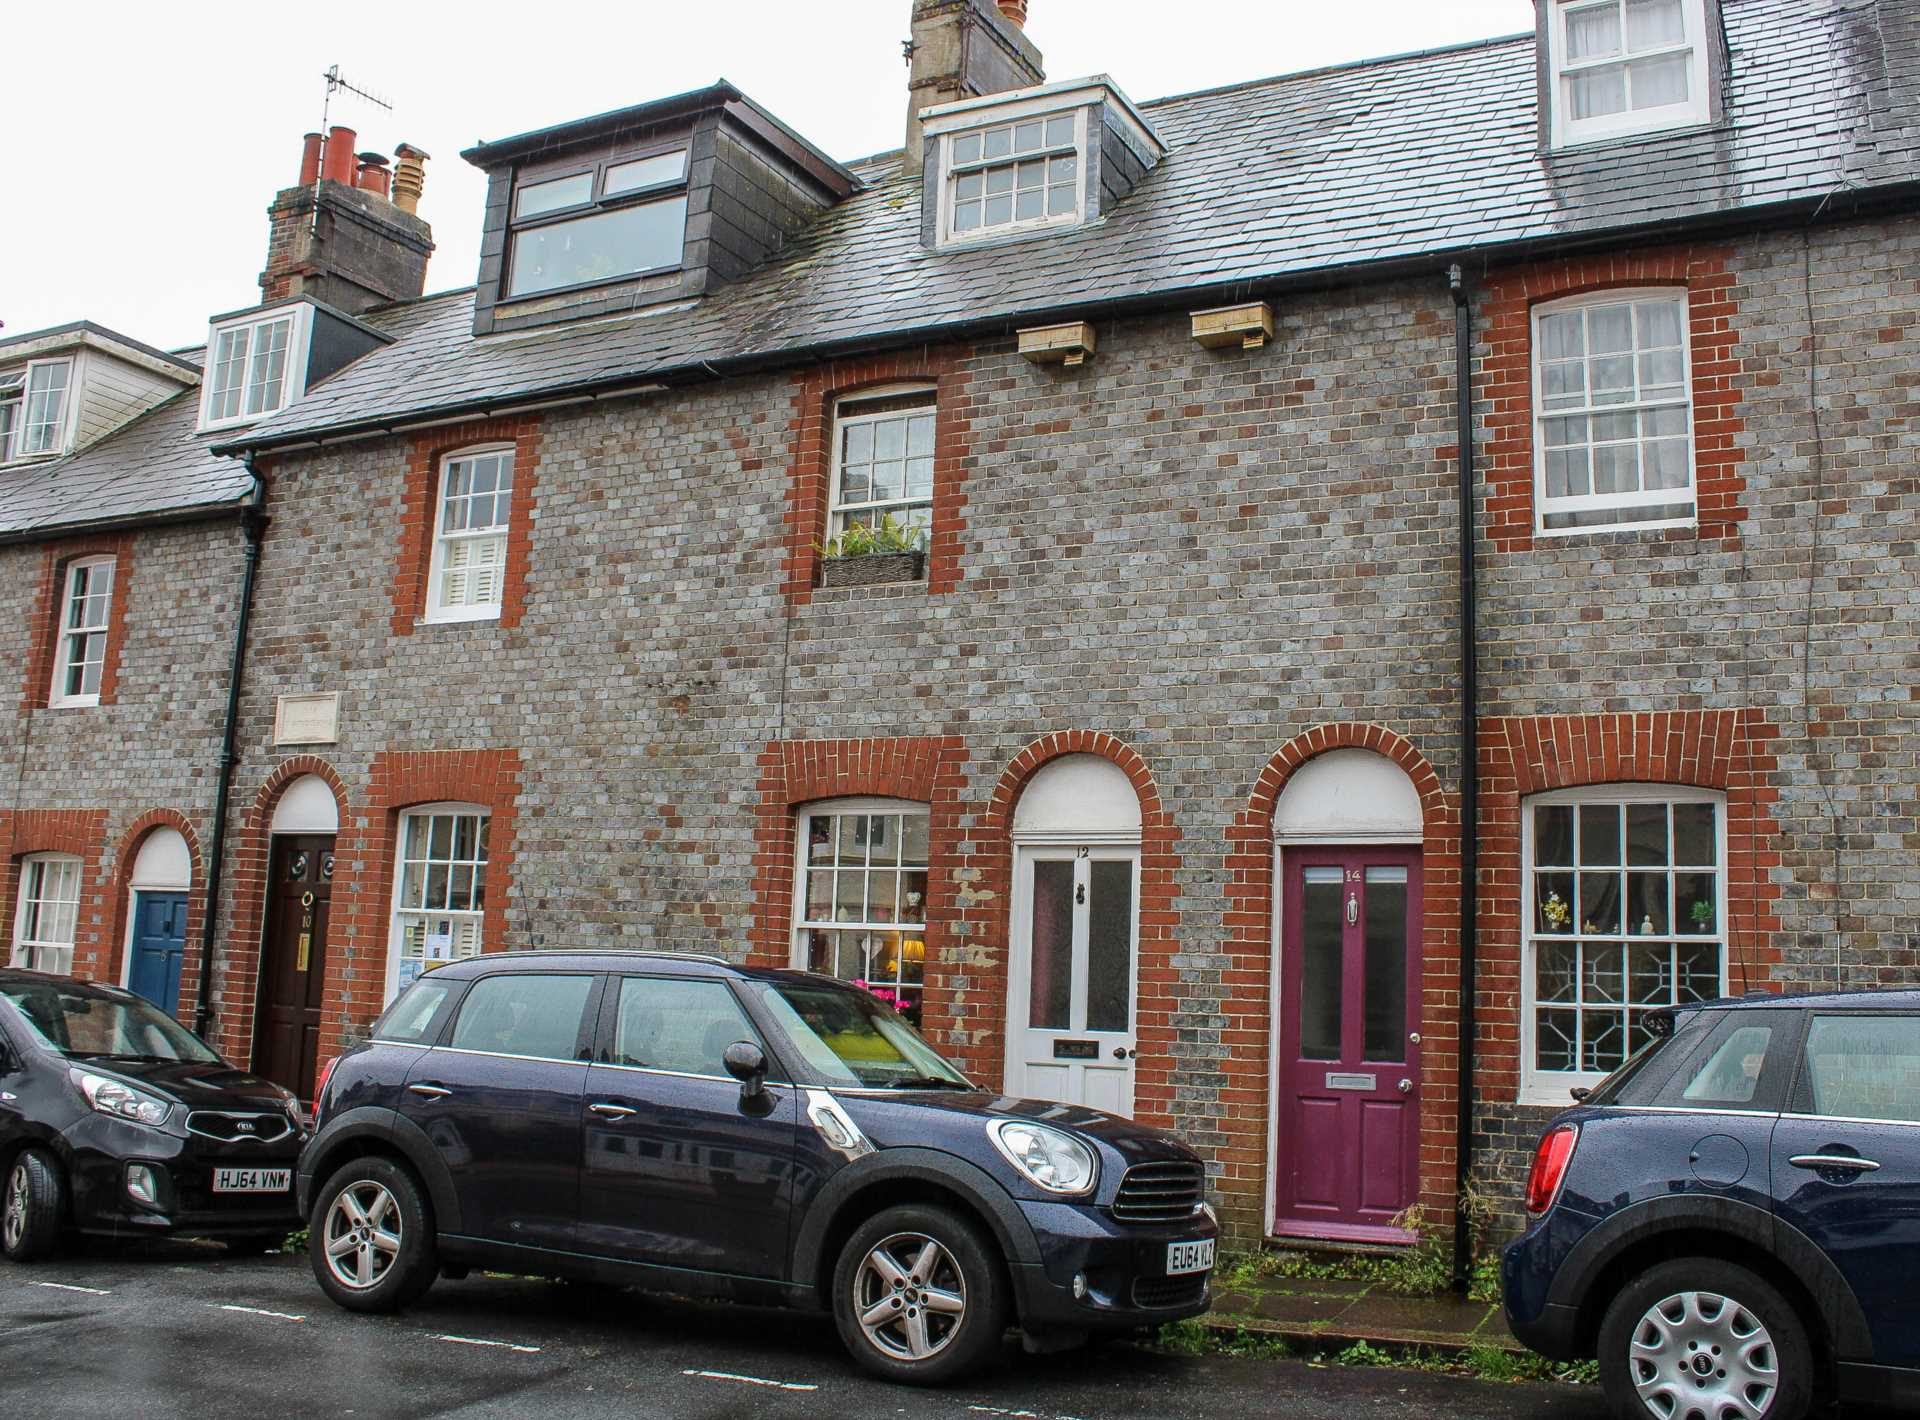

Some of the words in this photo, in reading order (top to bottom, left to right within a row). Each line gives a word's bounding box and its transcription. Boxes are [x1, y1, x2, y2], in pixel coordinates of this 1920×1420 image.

[1076, 846, 1089, 858] 12
[1345, 870, 1361, 882] 14
[302, 915, 312, 929] 10
[220, 1171, 257, 1188] HJ64
[262, 1171, 286, 1188] VNW
[1172, 1245, 1199, 1270] EU64
